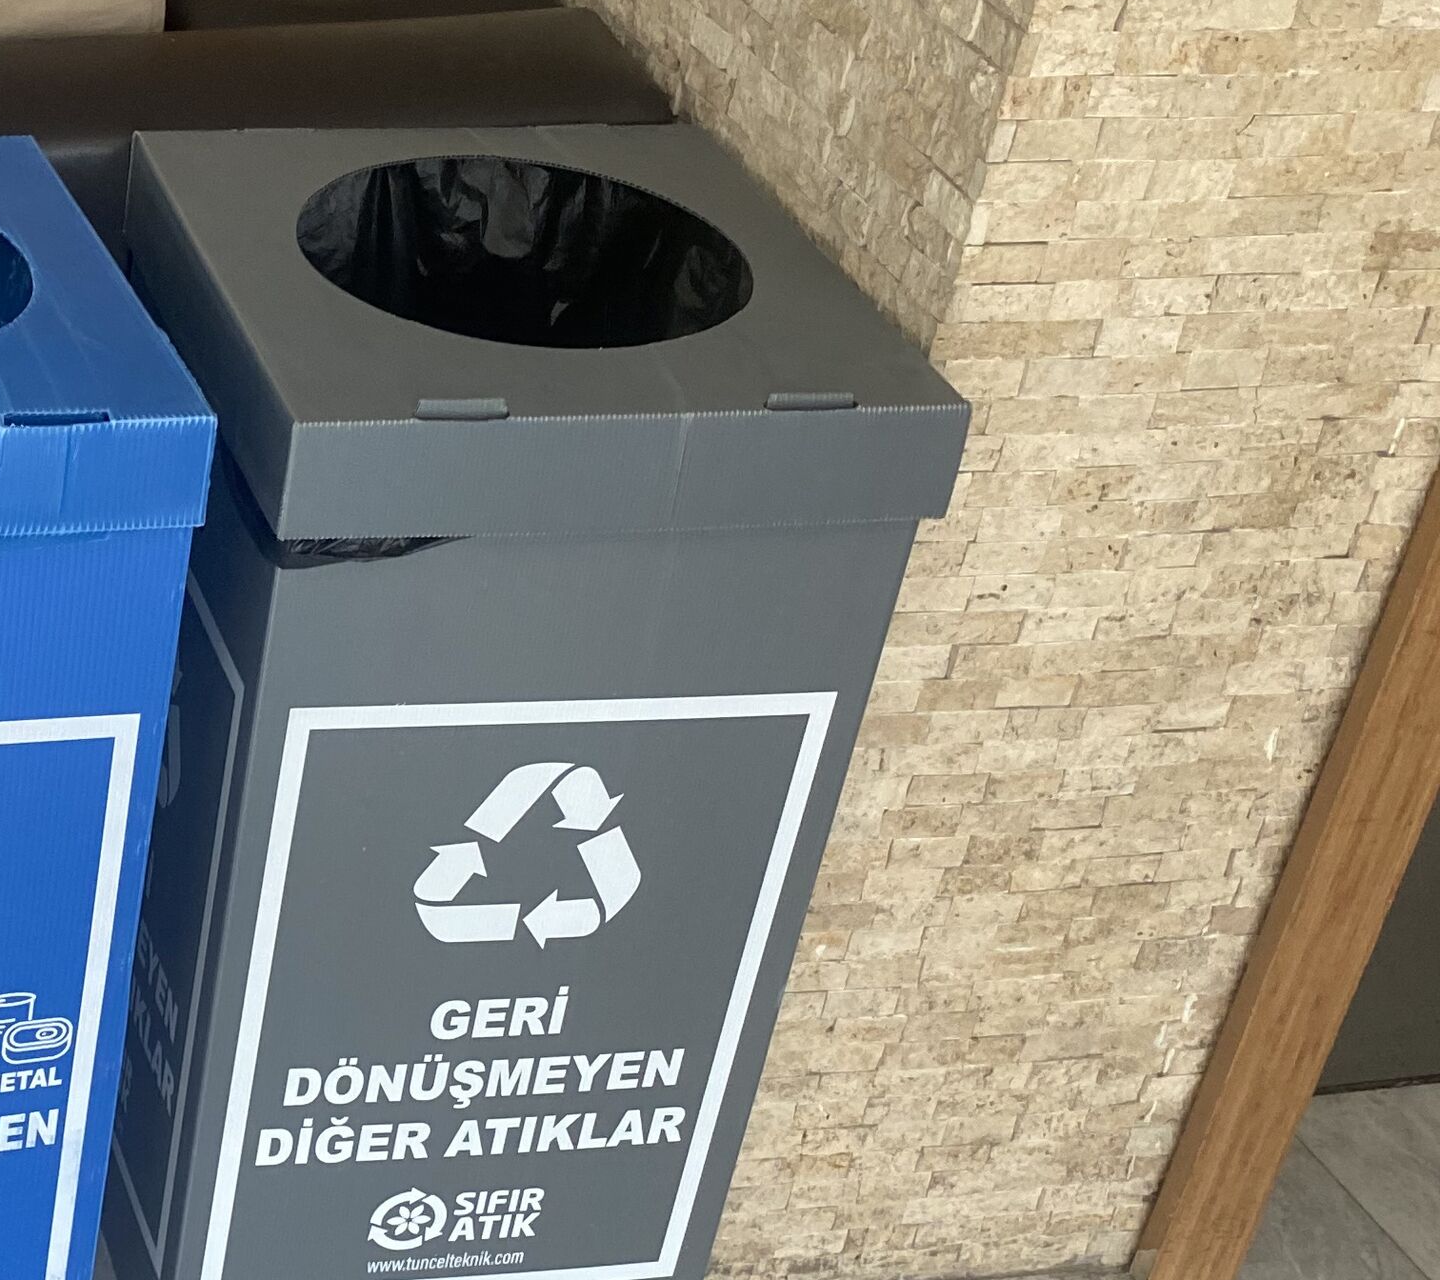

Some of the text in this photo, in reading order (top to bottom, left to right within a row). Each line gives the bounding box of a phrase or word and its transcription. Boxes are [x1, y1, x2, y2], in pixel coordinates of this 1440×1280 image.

[430, 985, 570, 1040] GERİ
[283, 1048, 685, 1109] DÖNÜŞMEYEN
[254, 1106, 686, 1166] DİĞER ATIKLAR
[453, 1187, 545, 1216] SIFIR
[447, 1212, 541, 1242] ATIK
[367, 1250, 525, 1274] www.tuncelteknik.com
